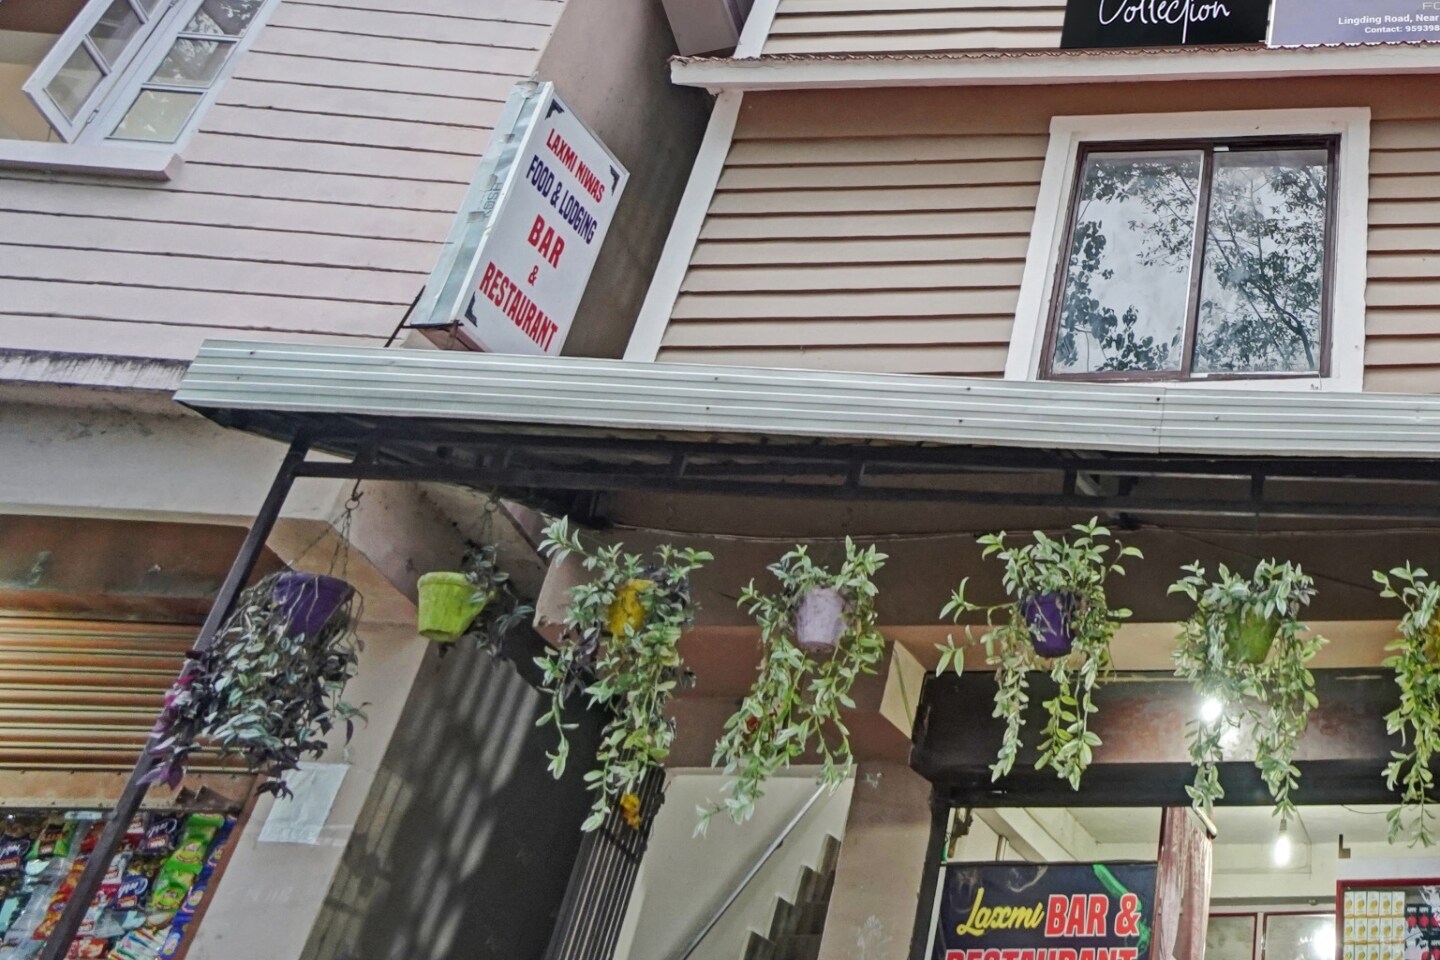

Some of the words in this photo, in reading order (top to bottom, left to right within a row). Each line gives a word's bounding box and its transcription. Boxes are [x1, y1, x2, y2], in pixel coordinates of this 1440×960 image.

[1338, 15, 1382, 26] Lingding
[1384, 14, 1413, 24] Road,
[1415, 13, 1440, 23] Near
[1364, 26, 1402, 34] Contact:
[546, 128, 578, 169] LAXMI
[576, 160, 605, 204] NIWAS
[525, 154, 555, 198] FOOD
[549, 181, 563, 208] &
[558, 188, 598, 245] LODGING
[527, 214, 565, 269] BAR
[527, 264, 539, 286] &
[479, 261, 559, 353] RESTAURANT
[956, 887, 1045, 937] Laxmi
[1044, 893, 1109, 937] BAR
[1113, 893, 1141, 937] &
